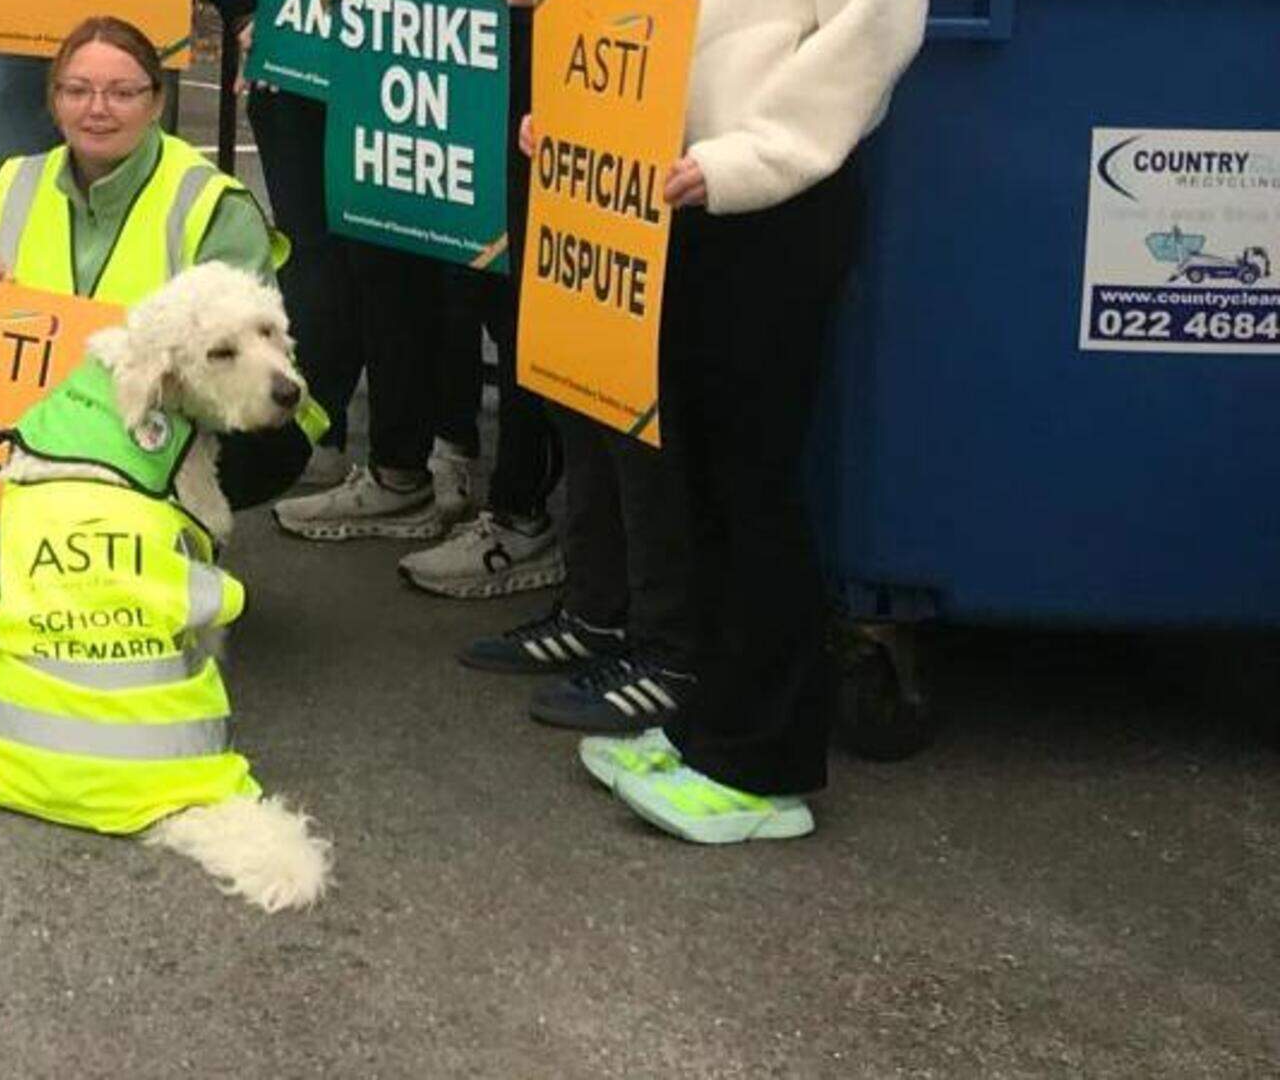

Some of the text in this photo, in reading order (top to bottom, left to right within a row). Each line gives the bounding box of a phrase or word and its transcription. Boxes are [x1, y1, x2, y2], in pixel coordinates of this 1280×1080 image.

[565, 33, 648, 101] ASTI
[380, 66, 448, 130] ON
[354, 127, 475, 205] HERE
[540, 135, 660, 223] OFFICIAL
[1134, 150, 1249, 174] COUNTRY
[538, 226, 647, 317] DISPUTE
[1099, 309, 1280, 339] 022 4684
[29, 531, 142, 579] ASTI
[28, 607, 151, 633] SCHOOL
[32, 637, 164, 661] STEWARD
